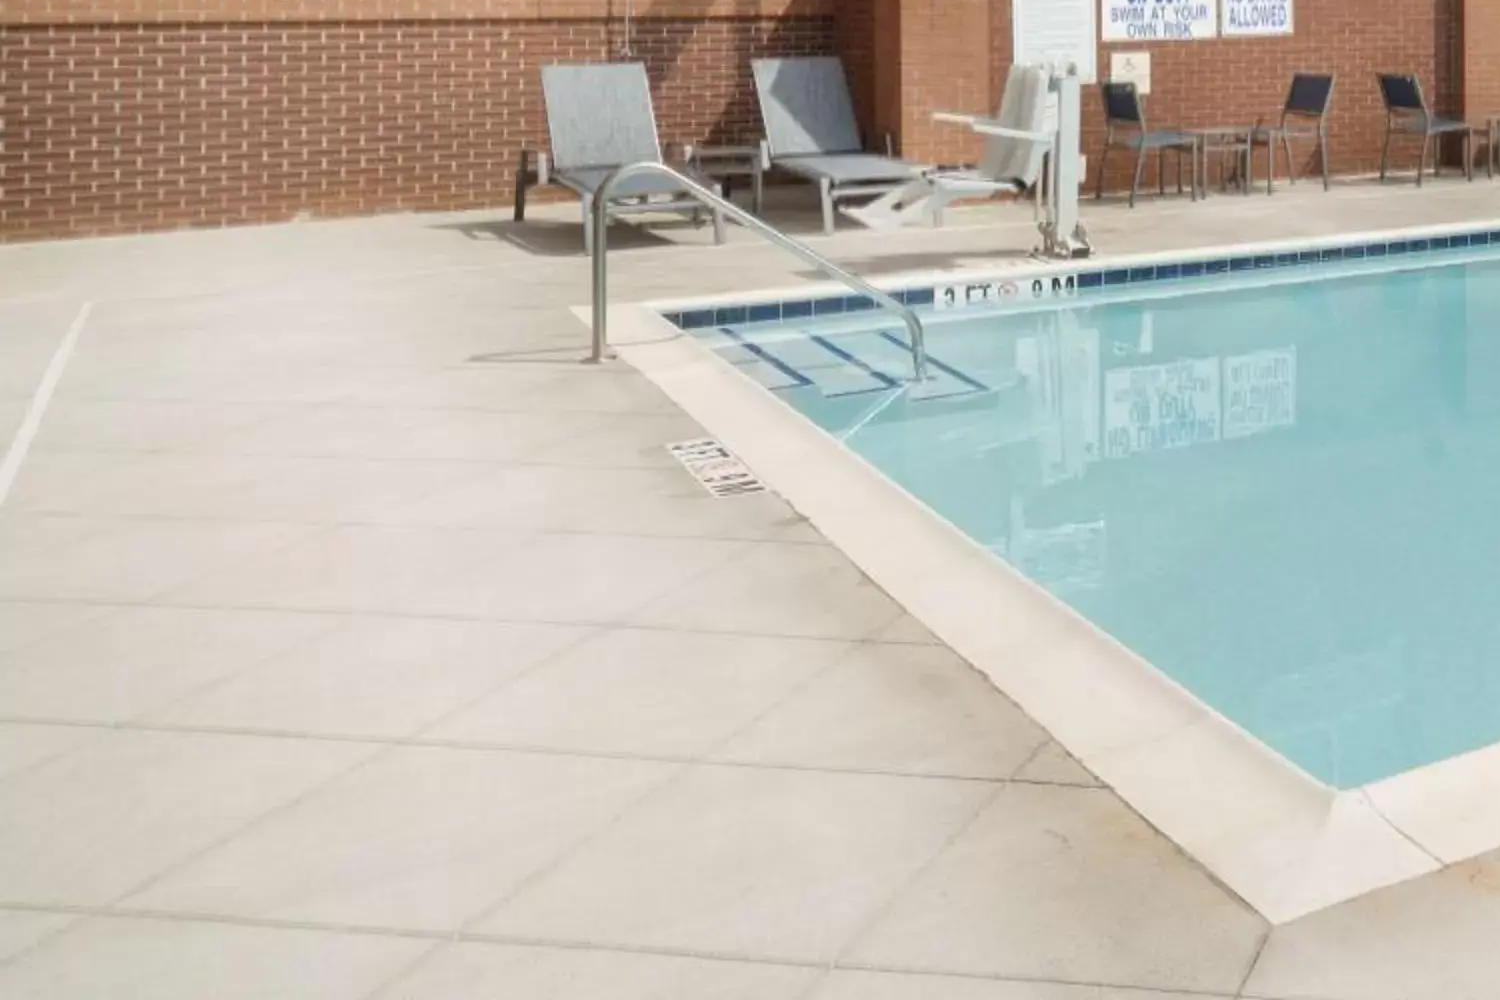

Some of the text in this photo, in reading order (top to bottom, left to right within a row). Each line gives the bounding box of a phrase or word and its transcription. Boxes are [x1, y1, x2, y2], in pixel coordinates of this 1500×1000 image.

[1111, 4, 1208, 22] SWIM AT YOUR
[1228, 4, 1287, 28] ALLOWED
[1126, 21, 1192, 38] OWN RISK
